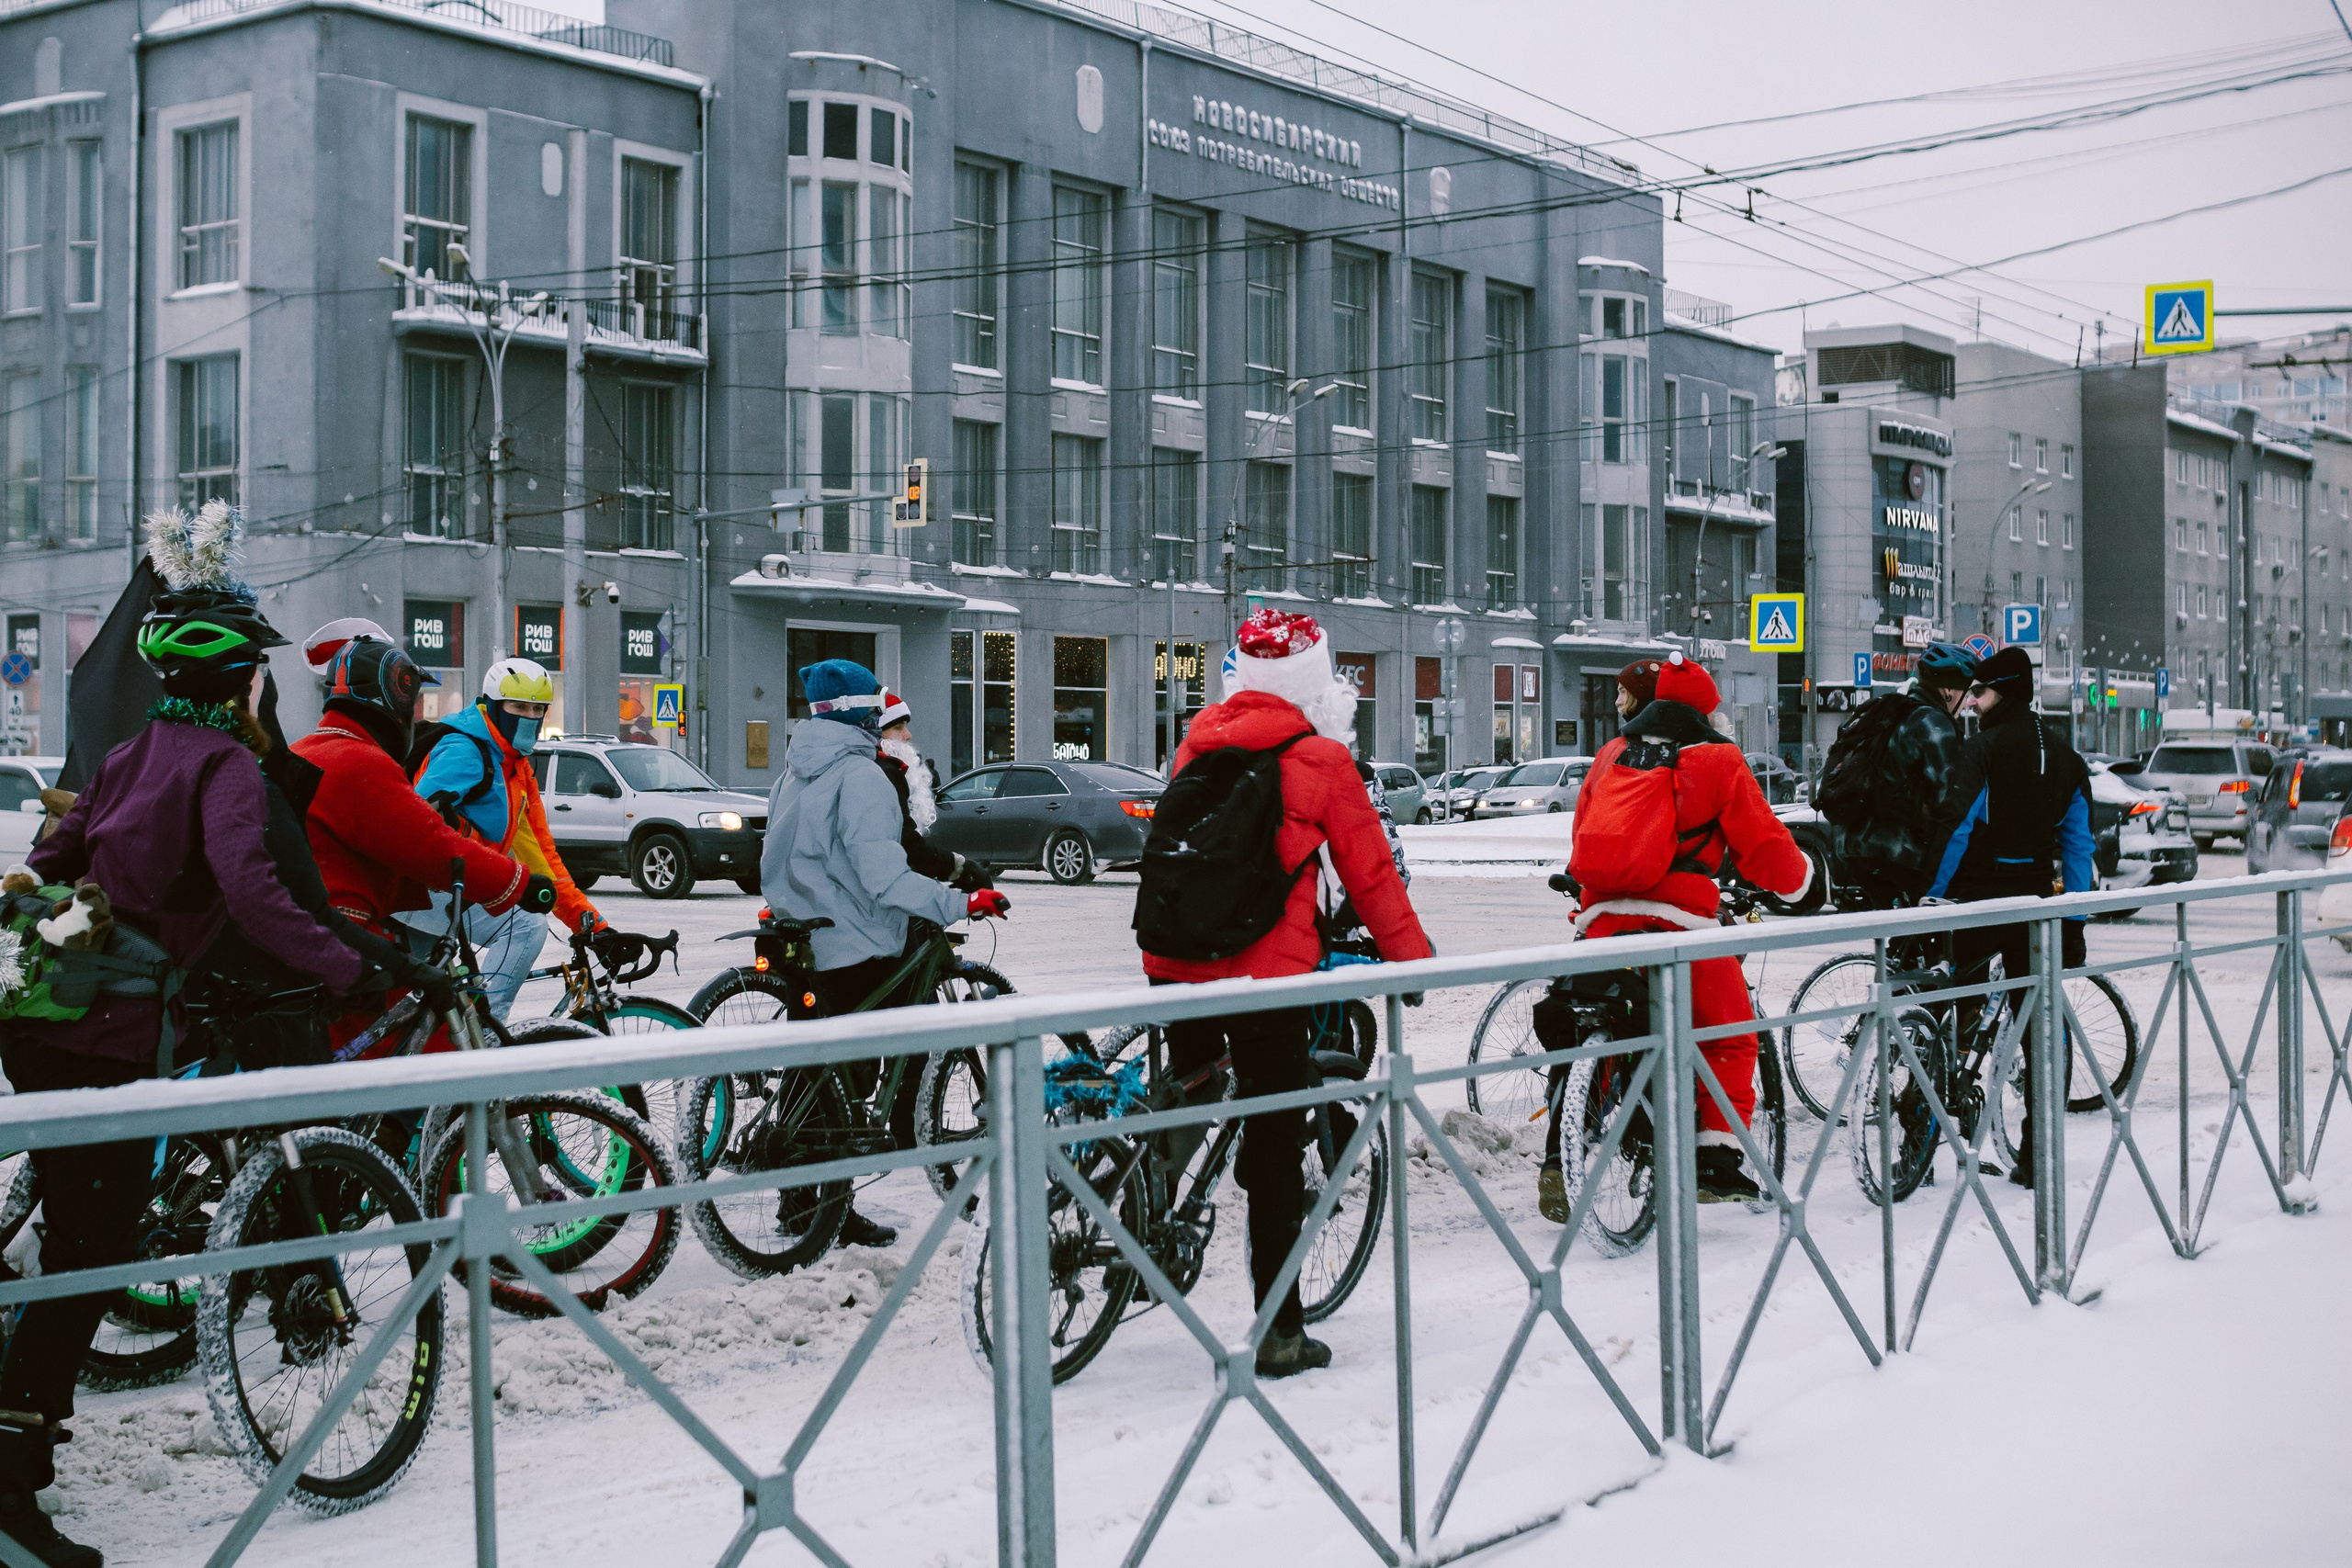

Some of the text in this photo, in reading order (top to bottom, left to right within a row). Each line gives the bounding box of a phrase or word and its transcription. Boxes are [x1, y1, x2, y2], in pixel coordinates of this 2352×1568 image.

[1148, 118, 1399, 210] СОЮЗ ПОТРЕБИТЕЛЬСКИХ ОБЩЕСТВ
[1886, 506, 1939, 534] NIRVANA
[1889, 581, 1906, 599] бар
[1909, 583, 1916, 597] &
[414, 618, 444, 634] РИВ
[525, 624, 553, 639] РИВ
[2012, 610, 2032, 640] P
[414, 633, 444, 649] ГОШ
[628, 629, 653, 643] РИВ
[525, 638, 553, 653] ГОШ
[628, 643, 653, 657] ГОШ
[1858, 657, 1867, 682] P
[1053, 742, 1090, 761] БАТОНО
